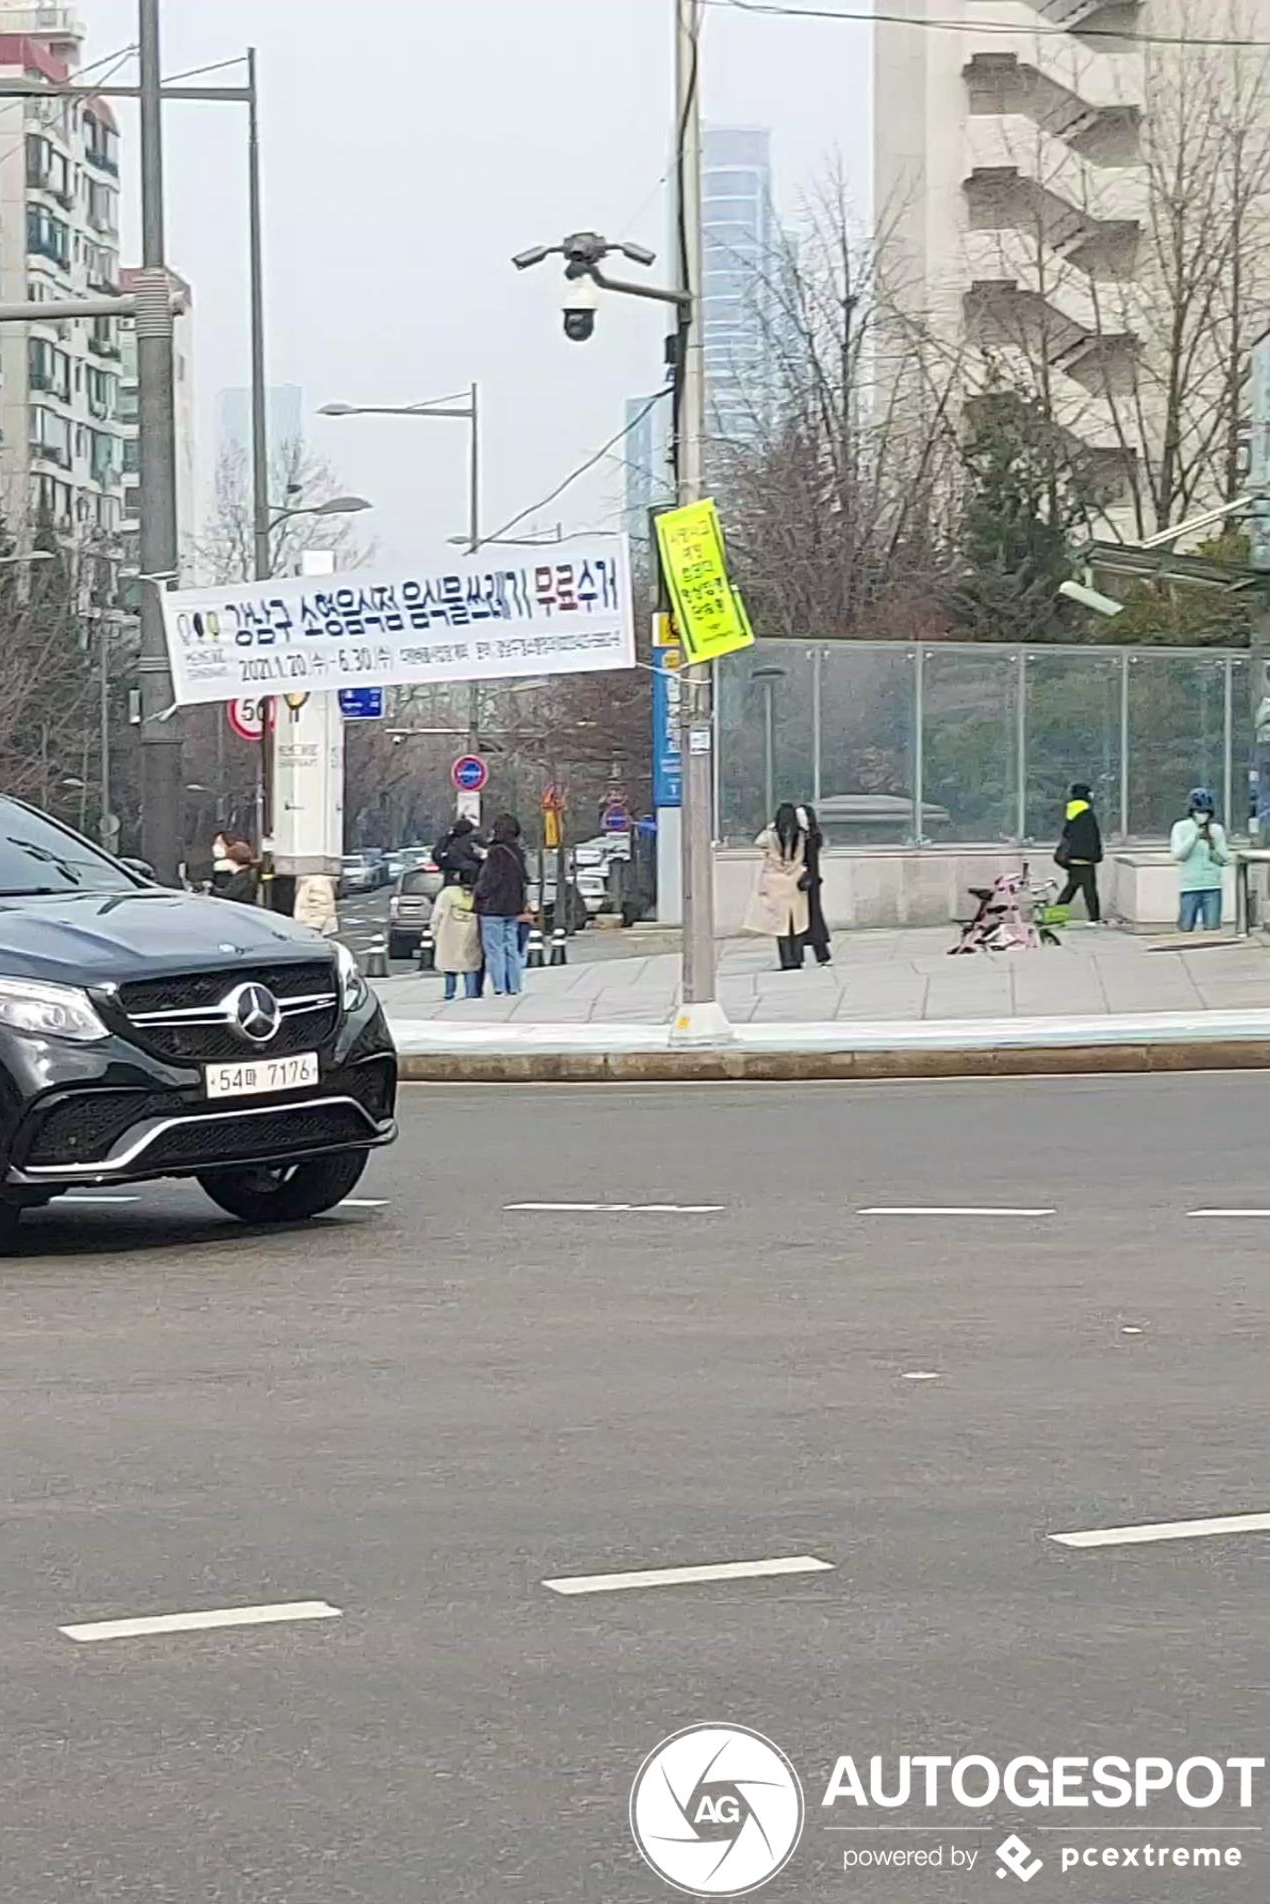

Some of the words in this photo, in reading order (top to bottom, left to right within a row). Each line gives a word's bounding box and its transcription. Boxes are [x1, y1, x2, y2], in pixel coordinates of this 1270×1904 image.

[225, 599, 293, 647] 강남구
[403, 568, 532, 629] 음식물쓰레기
[535, 557, 619, 618] 무료수거
[268, 1060, 310, 1086] 7176
